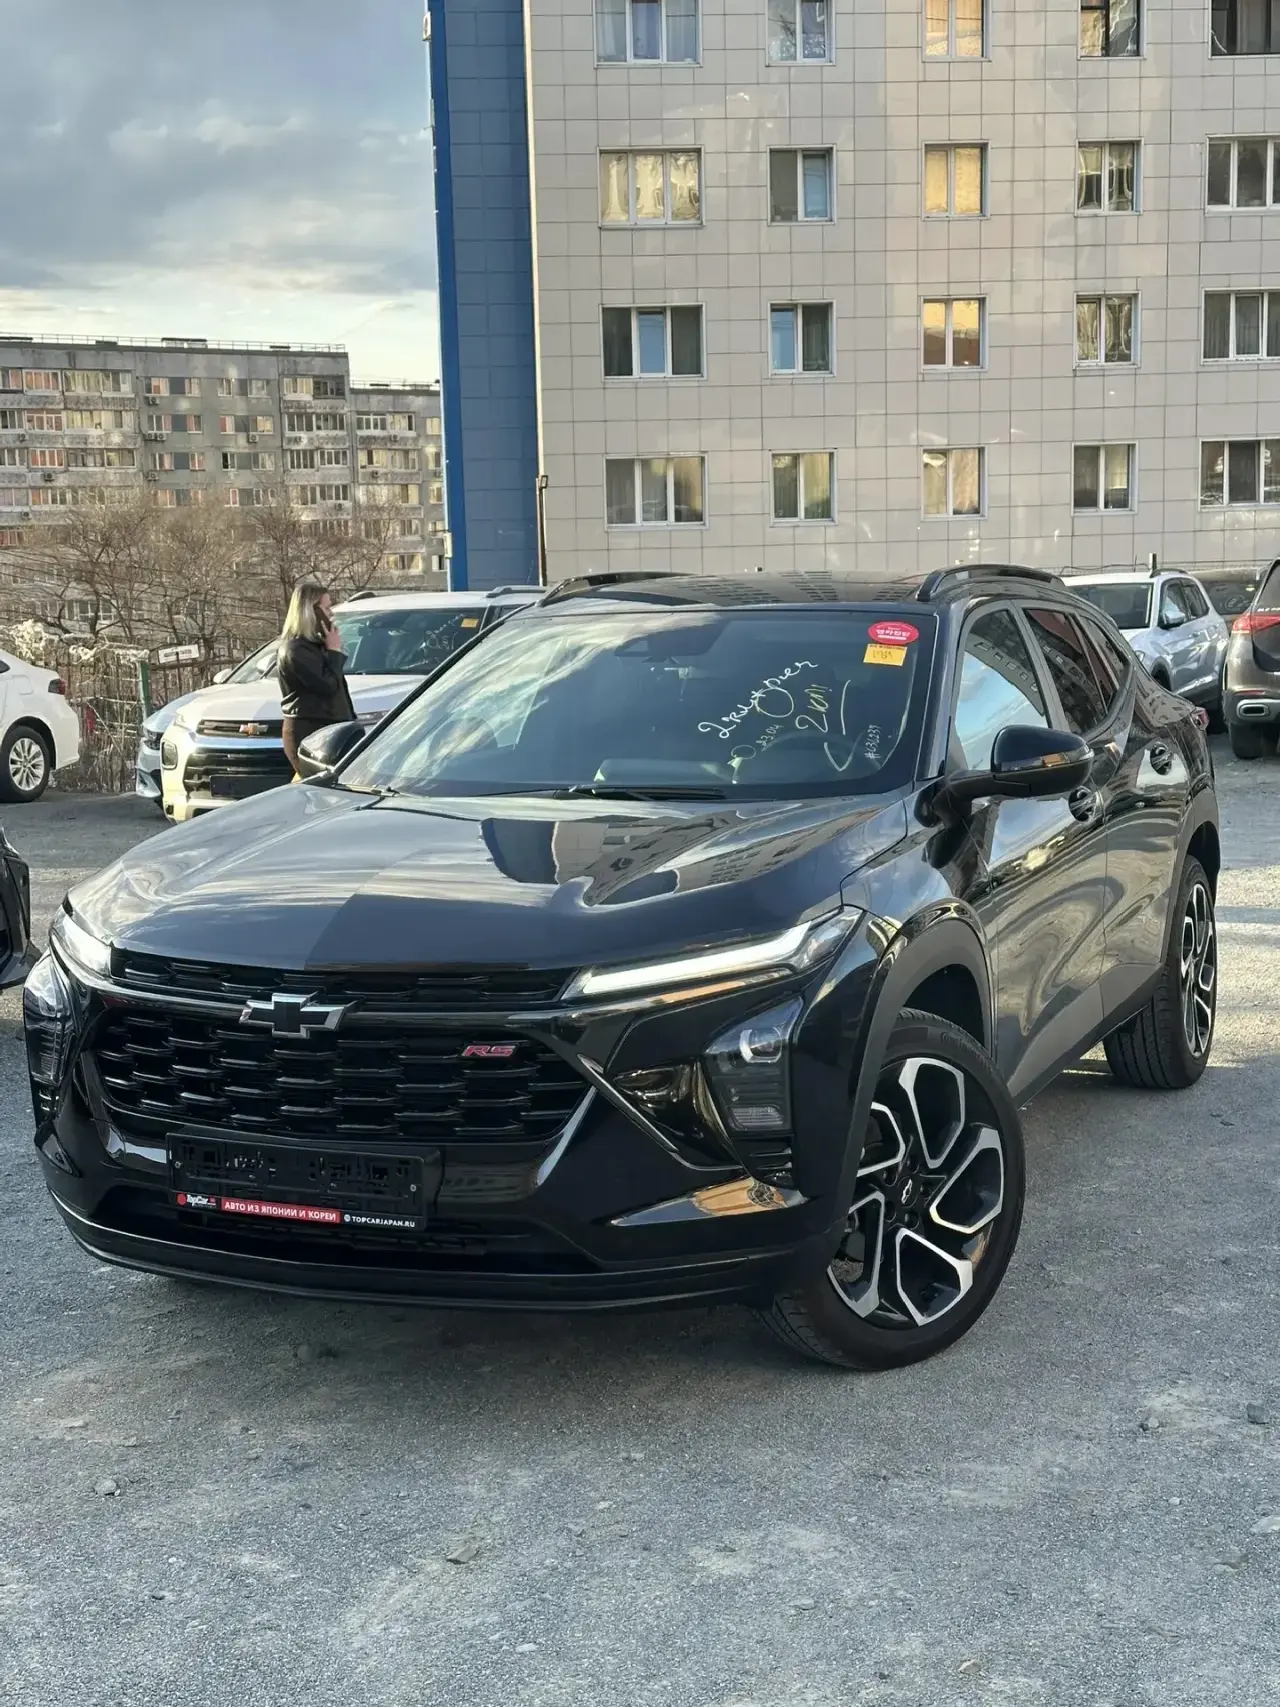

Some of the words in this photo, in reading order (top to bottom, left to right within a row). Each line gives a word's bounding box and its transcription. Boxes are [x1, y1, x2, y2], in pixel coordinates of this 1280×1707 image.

[461, 1045, 516, 1057] RS
[186, 1194, 209, 1207] TopCar
[224, 1201, 246, 1211] АВТО
[247, 1203, 260, 1213] ИЗ
[261, 1205, 298, 1217] ЯПОНИИ
[299, 1209, 306, 1218] И
[352, 1215, 416, 1228] TOPCARJAPAN.RU
